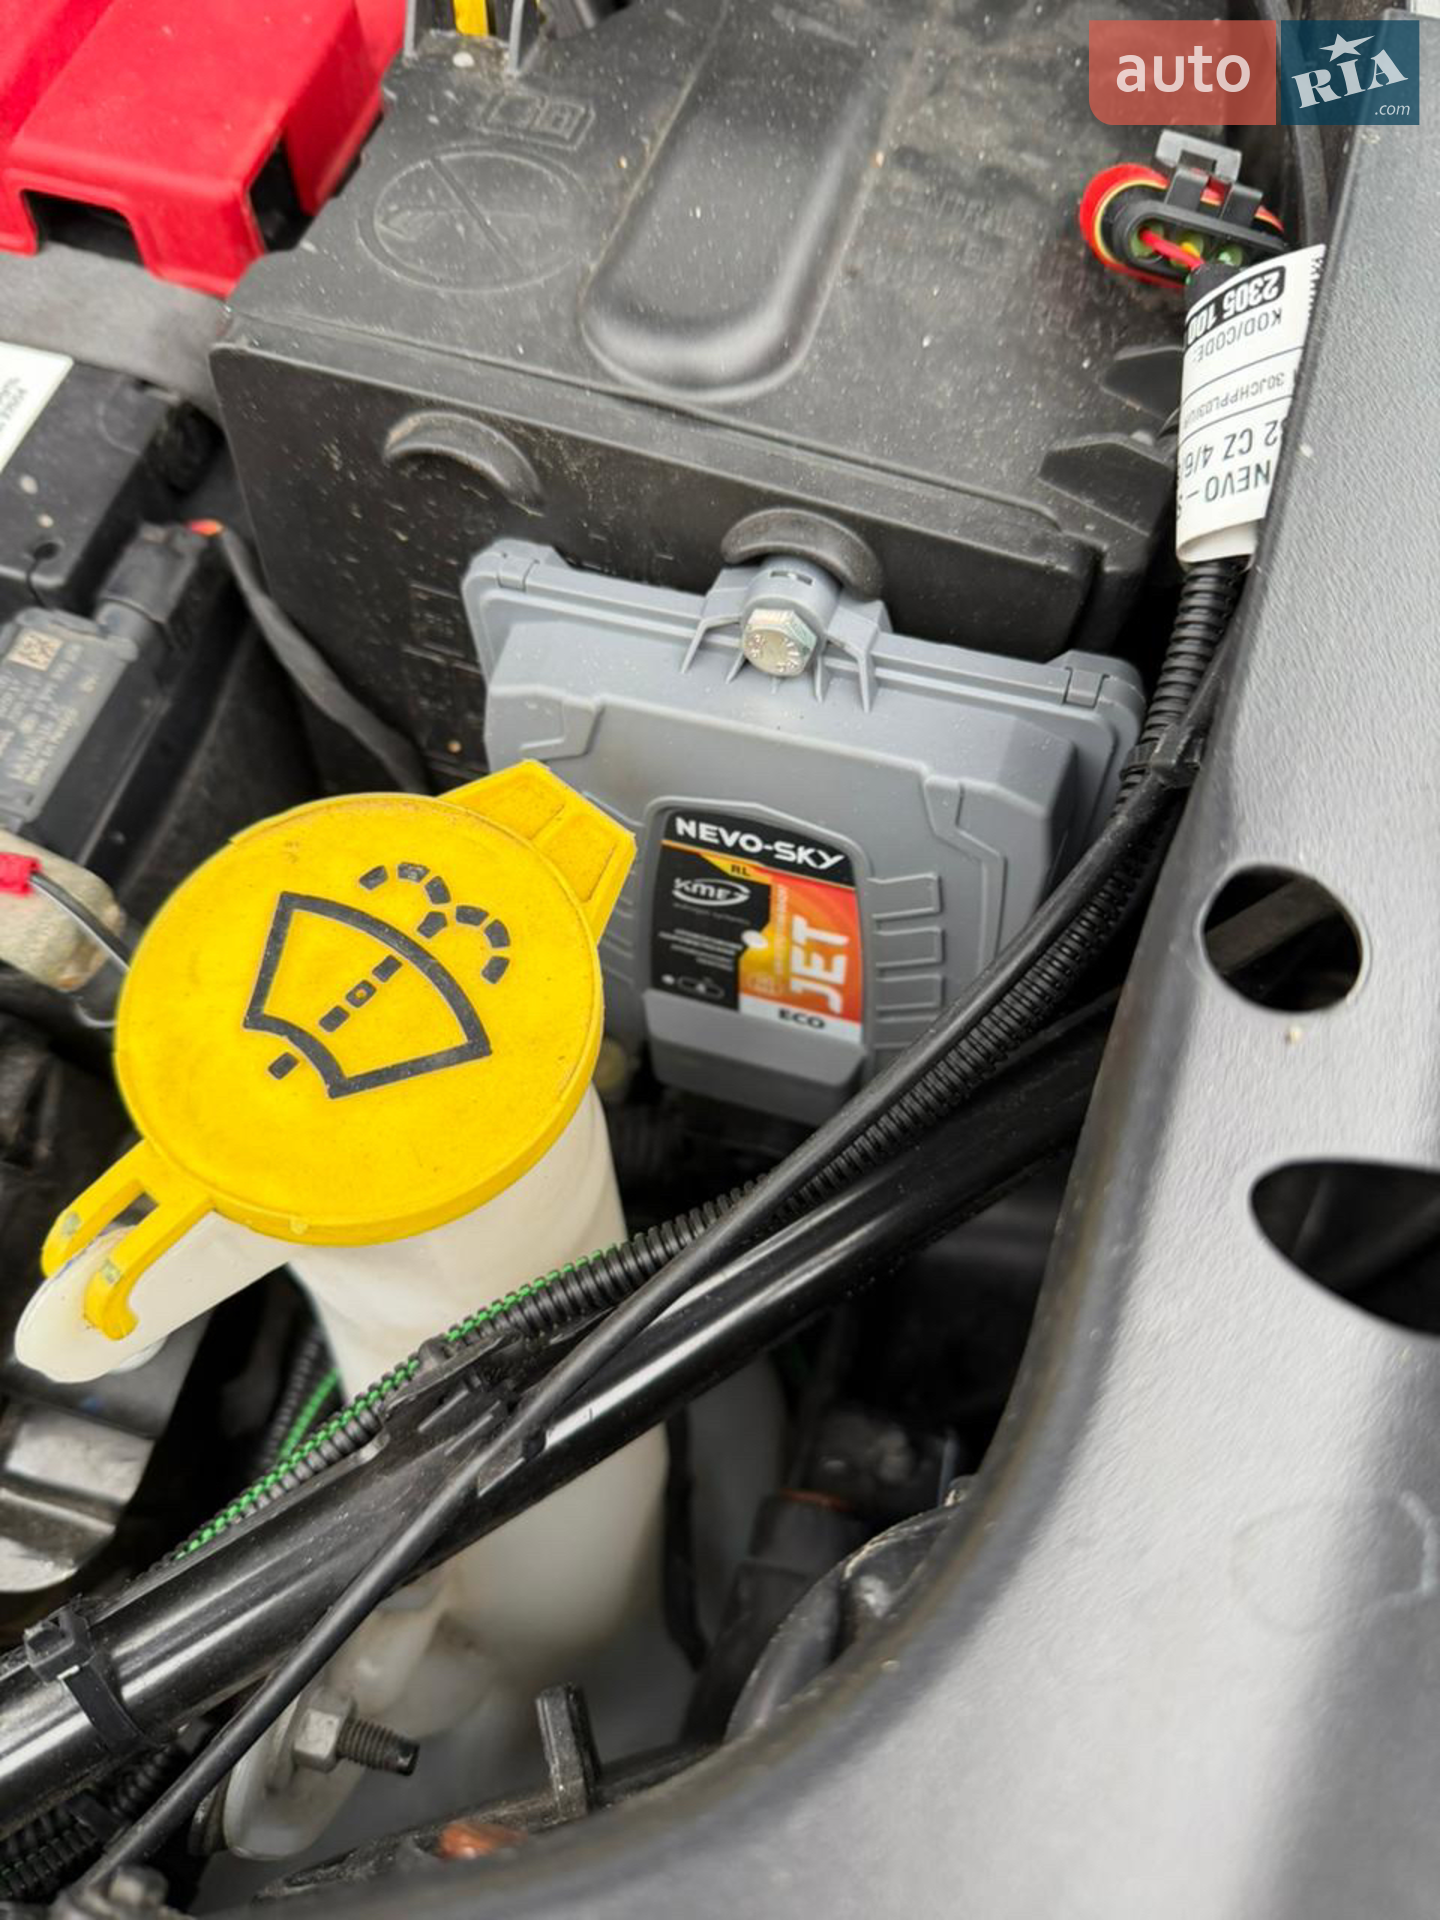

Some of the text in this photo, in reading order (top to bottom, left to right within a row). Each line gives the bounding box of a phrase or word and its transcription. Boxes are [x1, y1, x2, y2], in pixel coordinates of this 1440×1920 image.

[1222, 270, 1281, 319] 2305
[1223, 427, 1253, 461] CZ
[675, 816, 846, 870] NEVO-SKY
[790, 914, 849, 1015] JET
[778, 1008, 825, 1029] ECO
